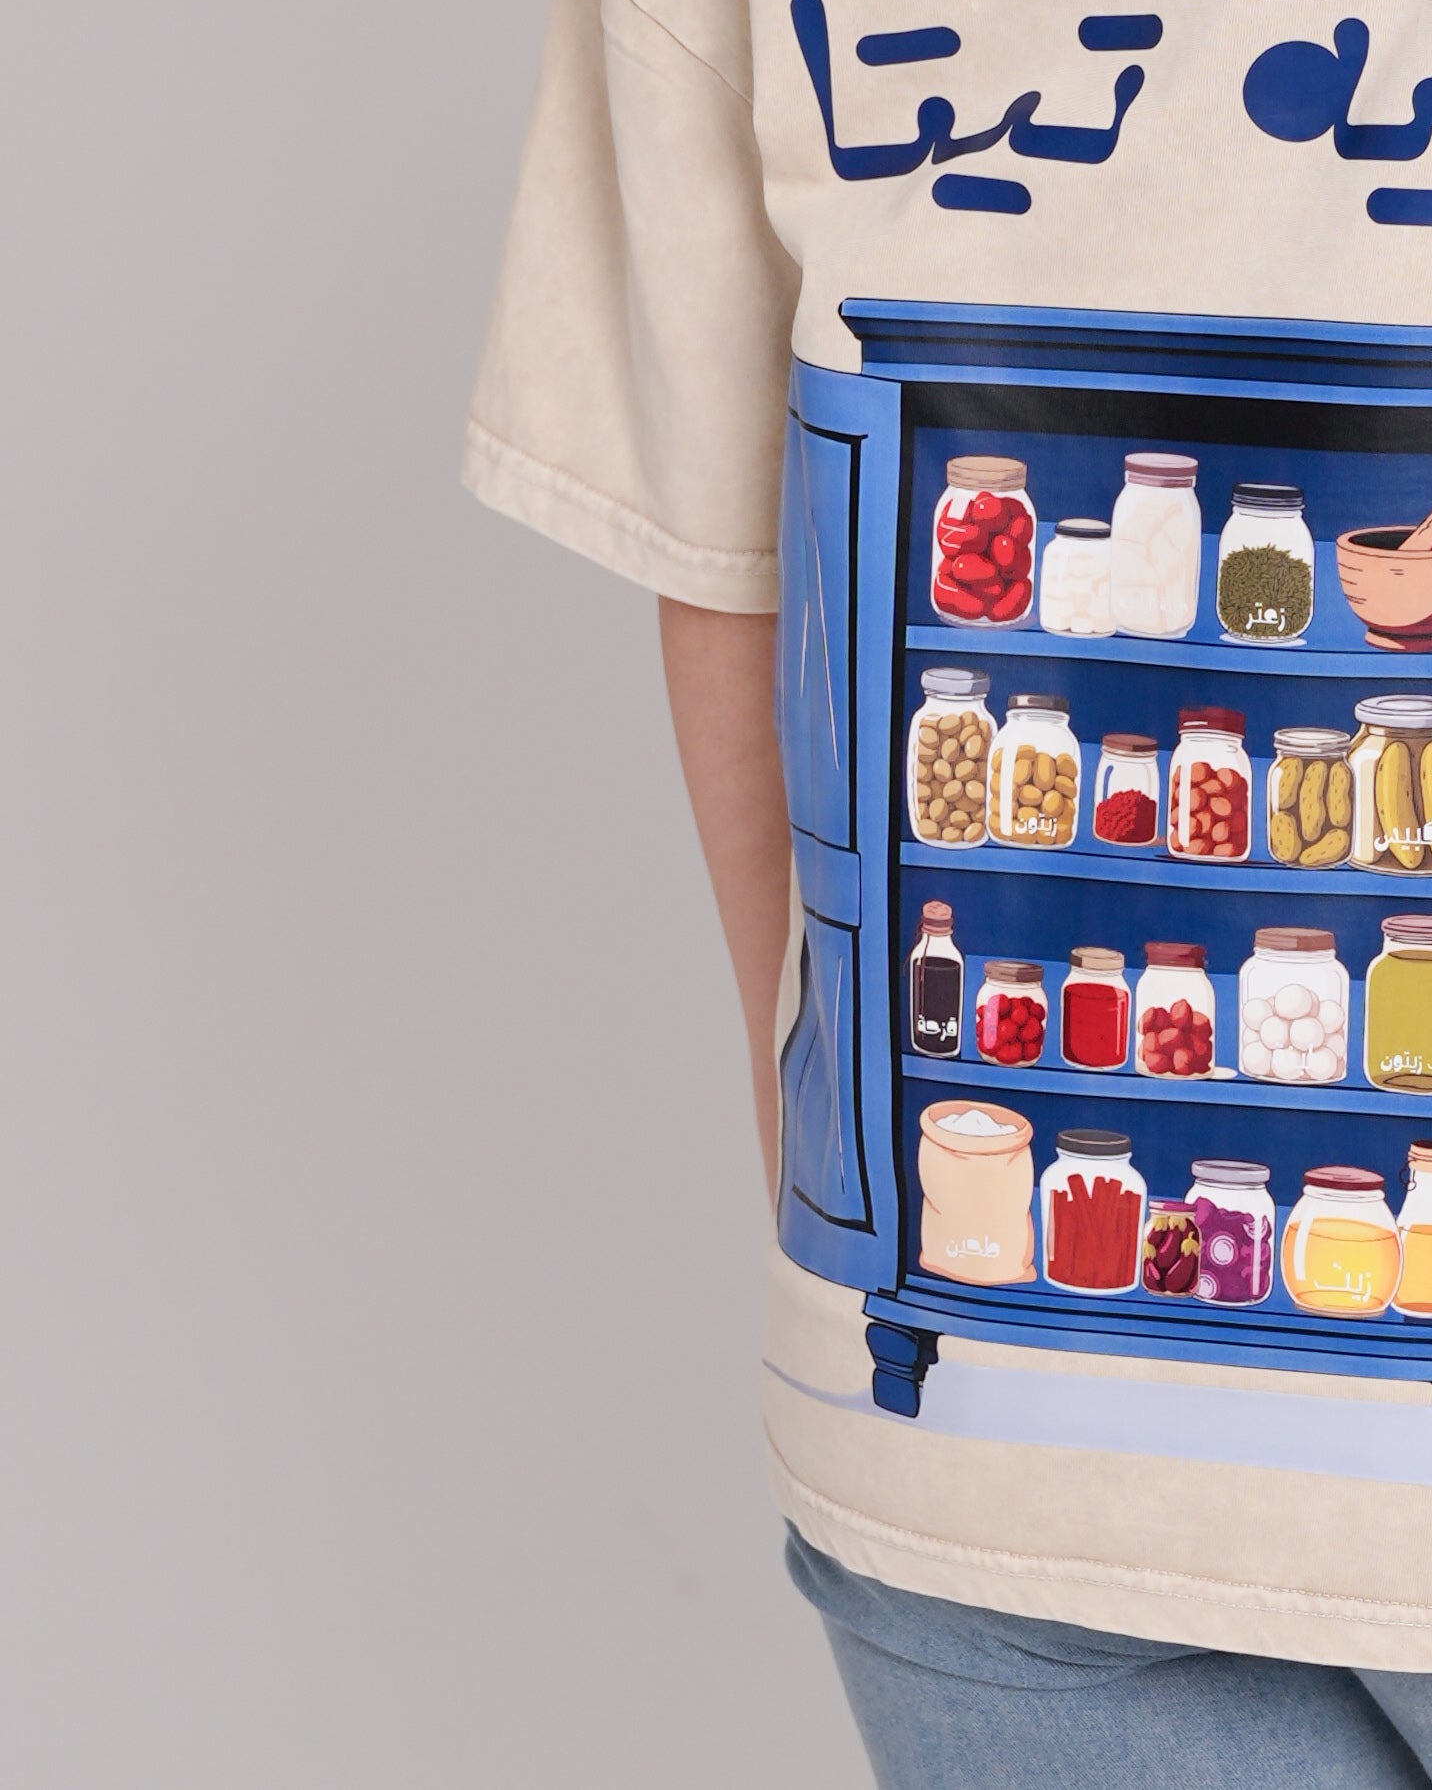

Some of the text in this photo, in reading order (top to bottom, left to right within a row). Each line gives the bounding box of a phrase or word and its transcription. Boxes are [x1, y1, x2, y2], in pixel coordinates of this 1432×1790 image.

[1245, 601, 1286, 632] زعتر
[1014, 812, 1058, 838] زيتون
[1380, 1050, 1423, 1075] زيتون
[945, 1233, 1001, 1259] طحين
[1313, 1260, 1372, 1304] زيت
